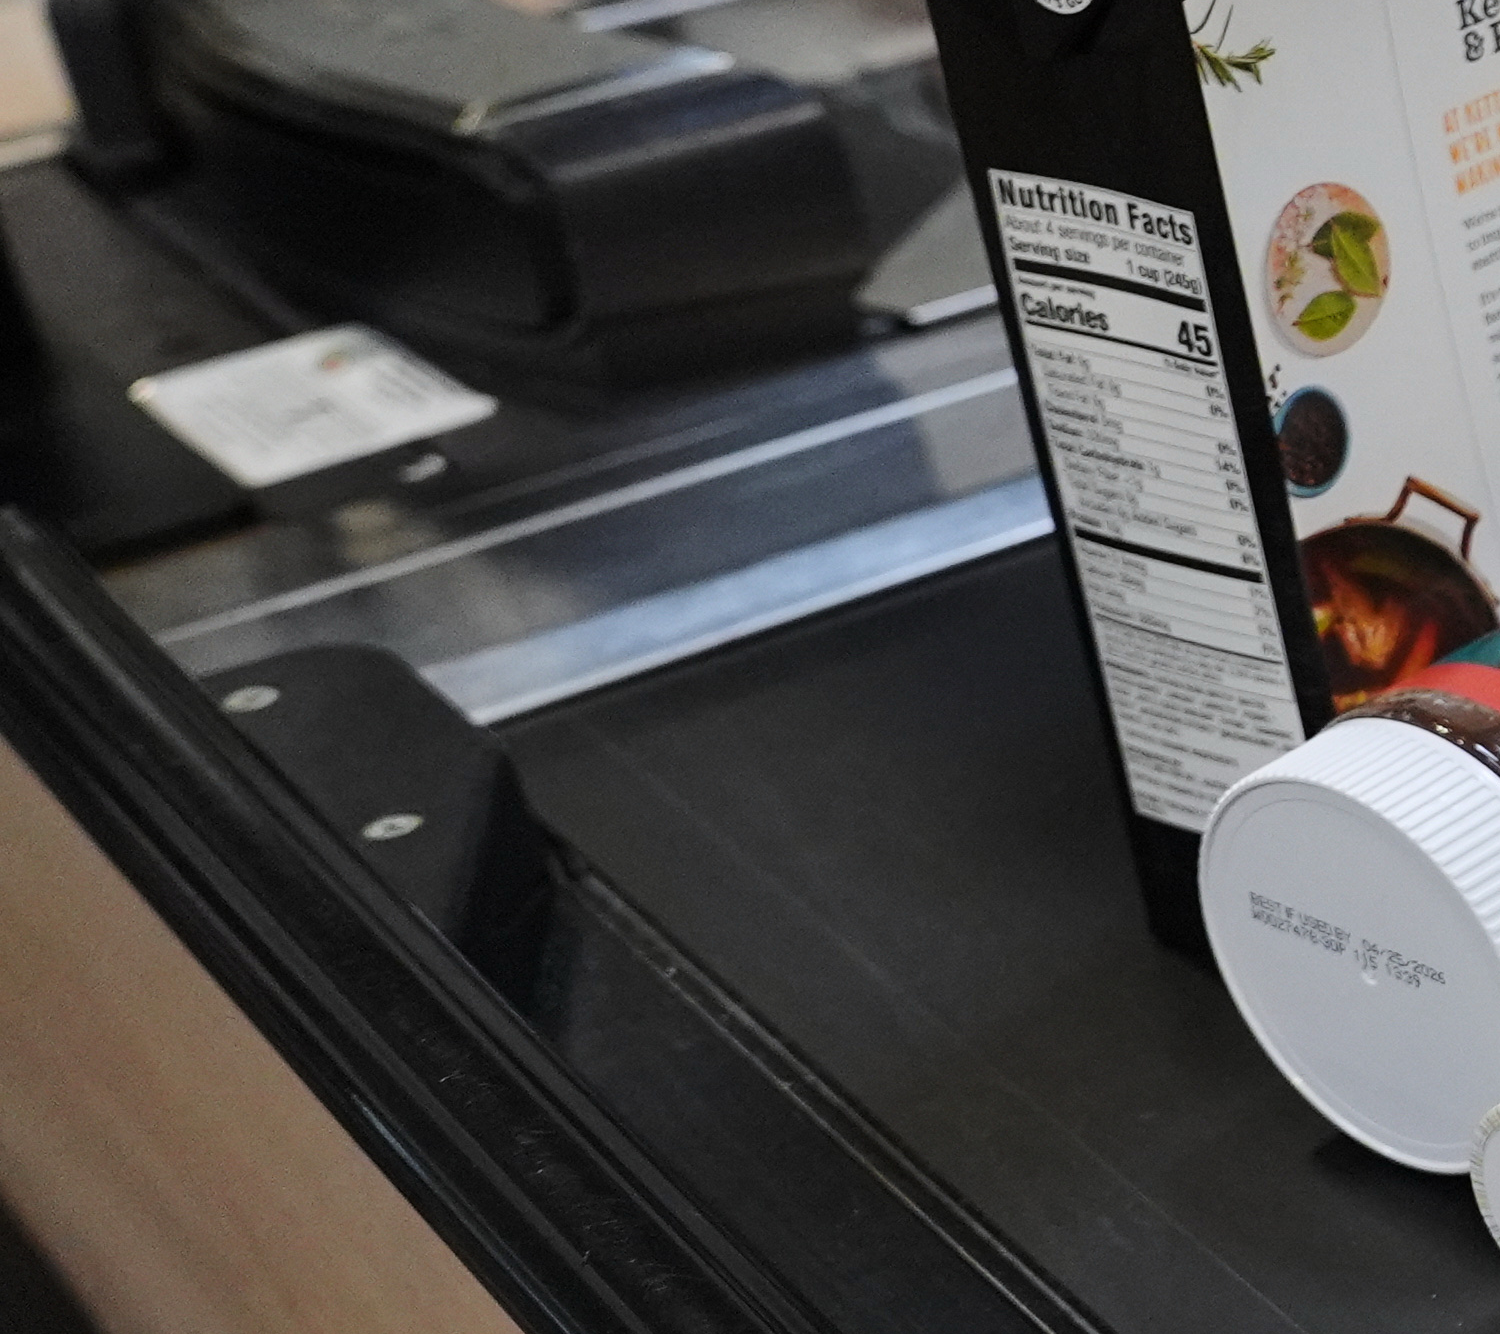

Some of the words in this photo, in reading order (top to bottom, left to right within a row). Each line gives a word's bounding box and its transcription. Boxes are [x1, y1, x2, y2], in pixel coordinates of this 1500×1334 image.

[1463, 31, 1485, 61] &
[1442, 106, 1459, 134] AT
[1449, 127, 1491, 164] WE'RE
[998, 177, 1118, 226] Nutrition
[1127, 202, 1194, 245] Facts
[1009, 236, 1062, 262] Serving
[1065, 248, 1091, 264] size
[1046, 220, 1055, 234] 4
[1060, 224, 1110, 251] servings
[1113, 235, 1131, 253] per
[1135, 240, 1185, 266] container
[1127, 258, 1135, 275] 1
[1138, 266, 1159, 283] cup
[1164, 269, 1203, 296] (245g)
[1020, 292, 1110, 332] Calories
[1177, 319, 1213, 357] 45
